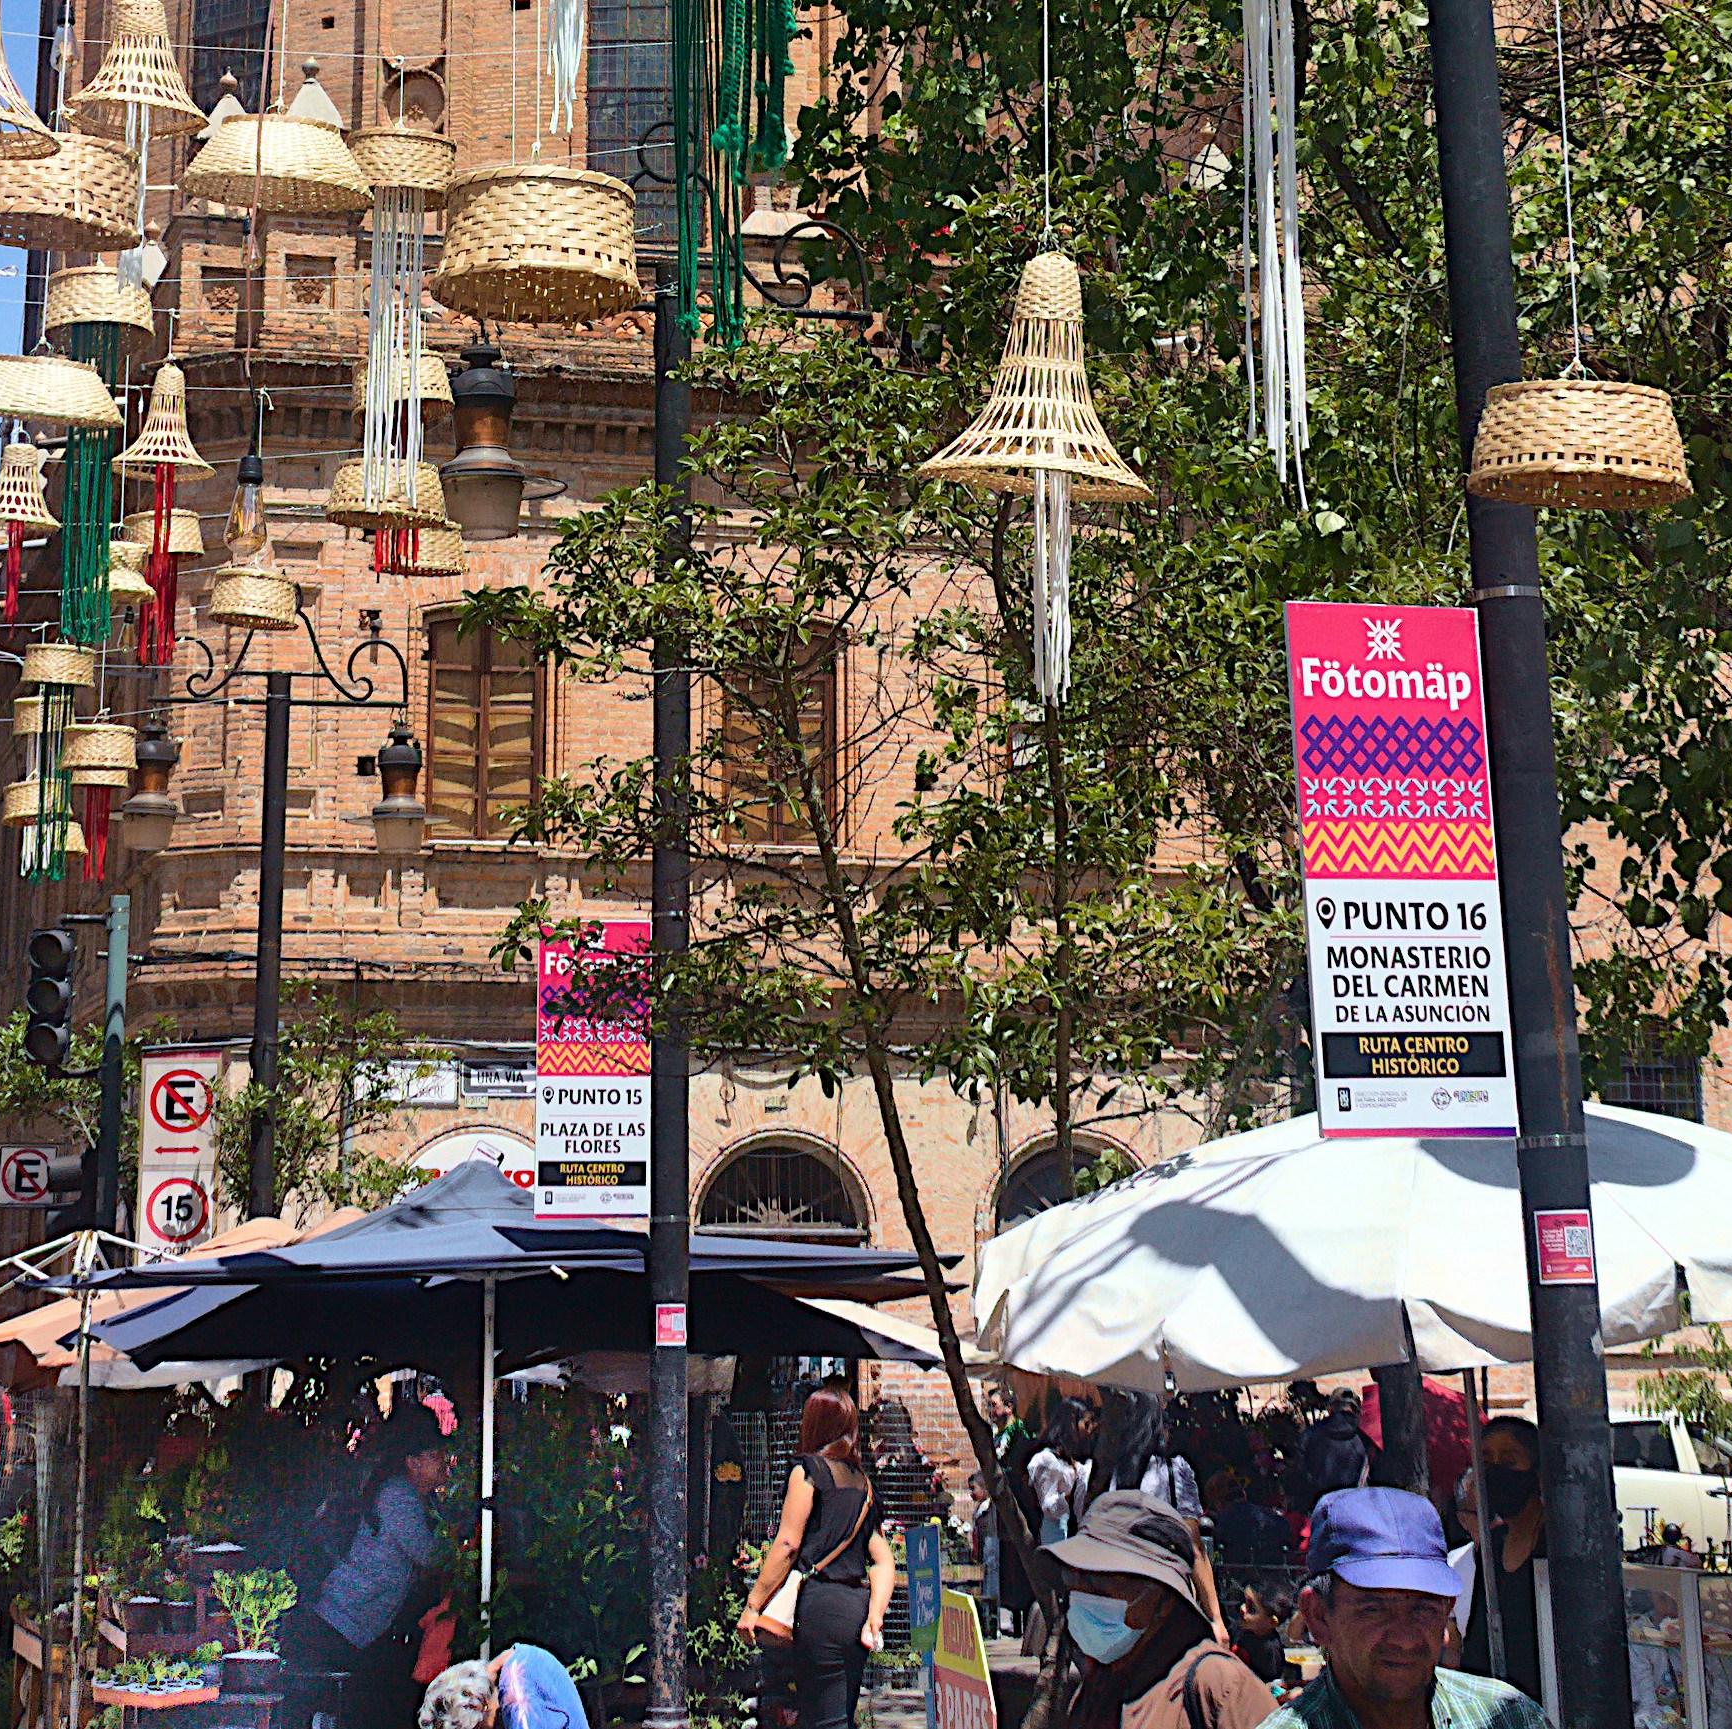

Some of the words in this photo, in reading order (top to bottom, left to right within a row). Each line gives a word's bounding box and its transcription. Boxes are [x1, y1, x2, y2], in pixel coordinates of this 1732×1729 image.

[1301, 657, 1472, 711] Fötomäp
[1343, 901, 1449, 930] PUNTO
[1457, 902, 1487, 931] 16
[1327, 945, 1491, 969] MONASTERIO
[1332, 975, 1378, 997] DEL
[1384, 975, 1489, 997] CARMEN
[1335, 1005, 1360, 1023] DE
[1365, 1005, 1388, 1022] LA
[1392, 1000, 1491, 1023] ASUNCIÓN
[1358, 1037, 1402, 1055] RUTA
[1404, 1036, 1470, 1054] CENTRO
[1371, 1054, 1460, 1075] HISTÓRICO
[478, 1071, 500, 1083] UNA
[505, 1071, 524, 1083] VIA
[165, 1080, 196, 1121] E
[558, 1089, 621, 1105] PUNTO
[626, 1089, 643, 1105] 15
[540, 1123, 588, 1137] PLAZA
[593, 1123, 613, 1137] DE
[618, 1123, 646, 1137] LAS
[565, 1139, 621, 1153] FLORES
[14, 1159, 41, 1193] E
[559, 1163, 585, 1174] RUTA
[586, 1163, 625, 1174] CENTRO
[566, 1173, 619, 1186] HISTÓRICO
[161, 1194, 193, 1222] 15
